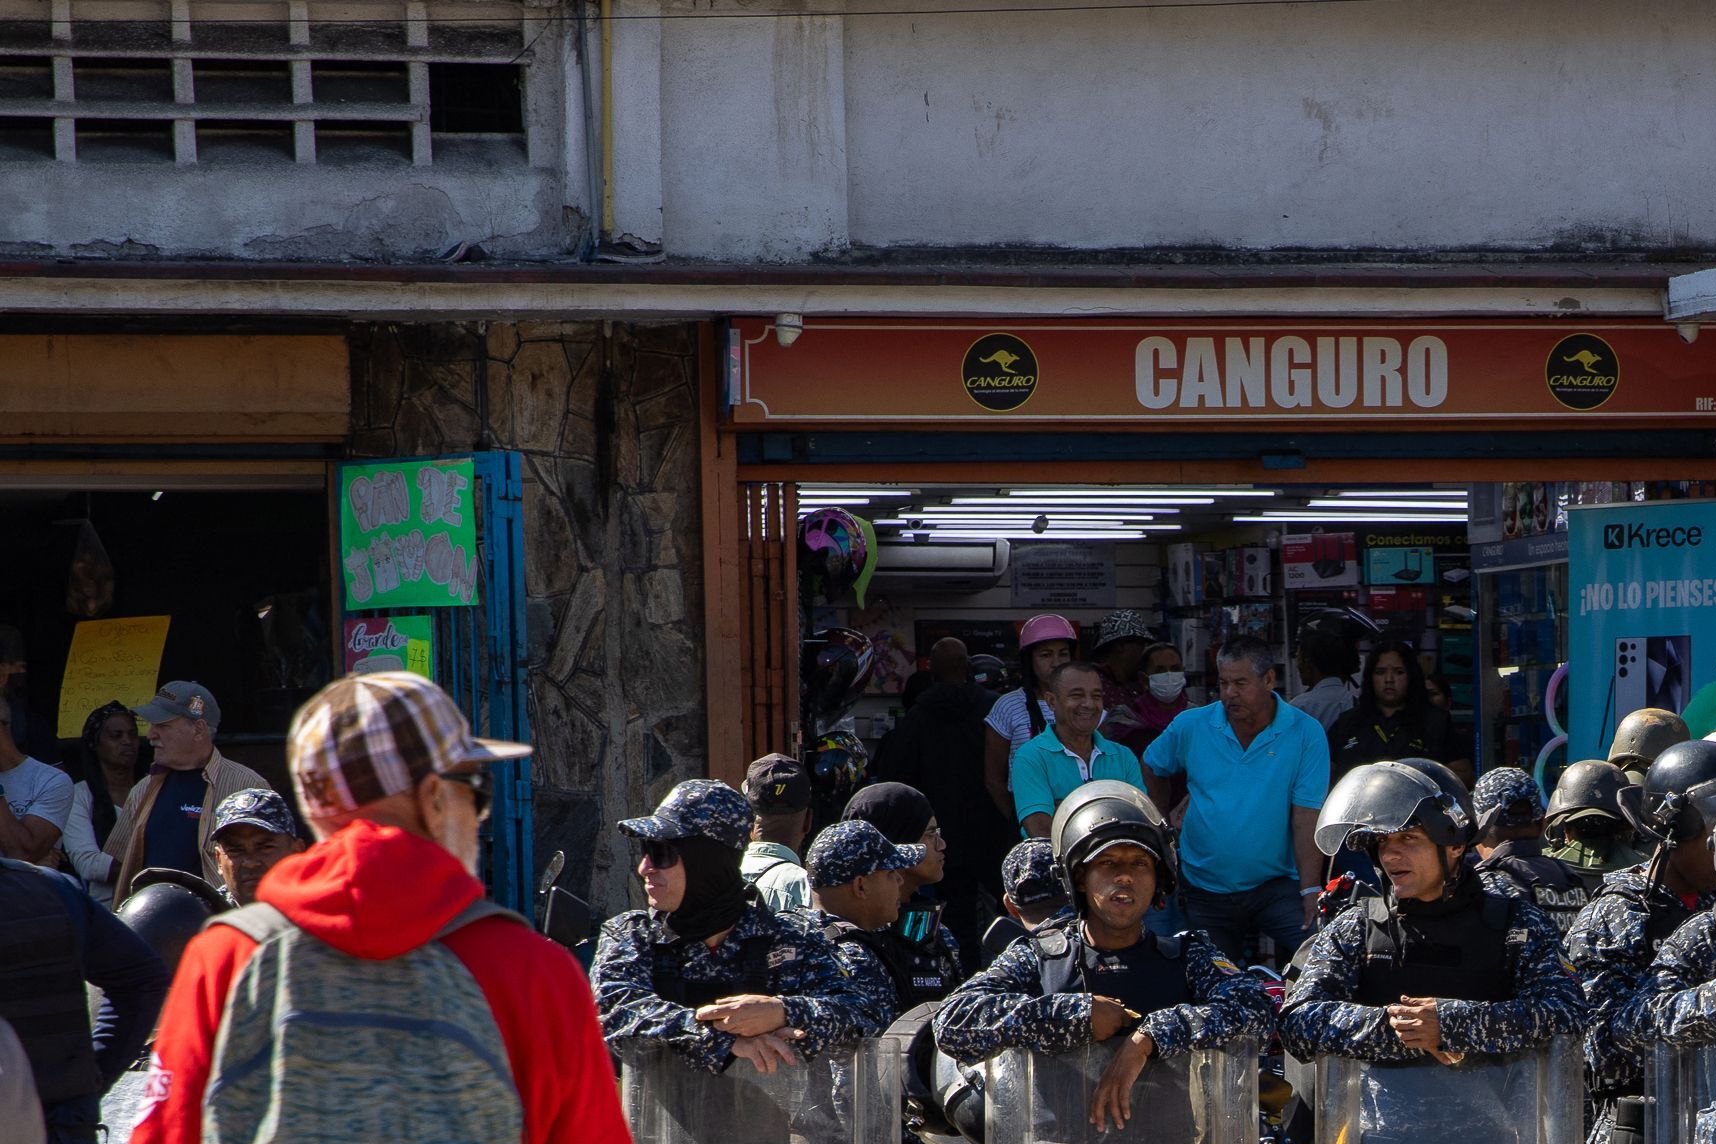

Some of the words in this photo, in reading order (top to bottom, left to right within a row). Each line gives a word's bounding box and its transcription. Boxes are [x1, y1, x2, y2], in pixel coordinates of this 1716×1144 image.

[1134, 335, 1449, 409] CANGURO
[967, 376, 1035, 388] CANGURO
[1550, 375, 1615, 386] CANGURO
[1696, 397, 1716, 411] RIF:
[1365, 533, 1450, 546] Conectamos
[1627, 522, 1702, 549] Krece
[1580, 583, 1613, 616] ¡NO
[1618, 582, 1642, 610] LO
